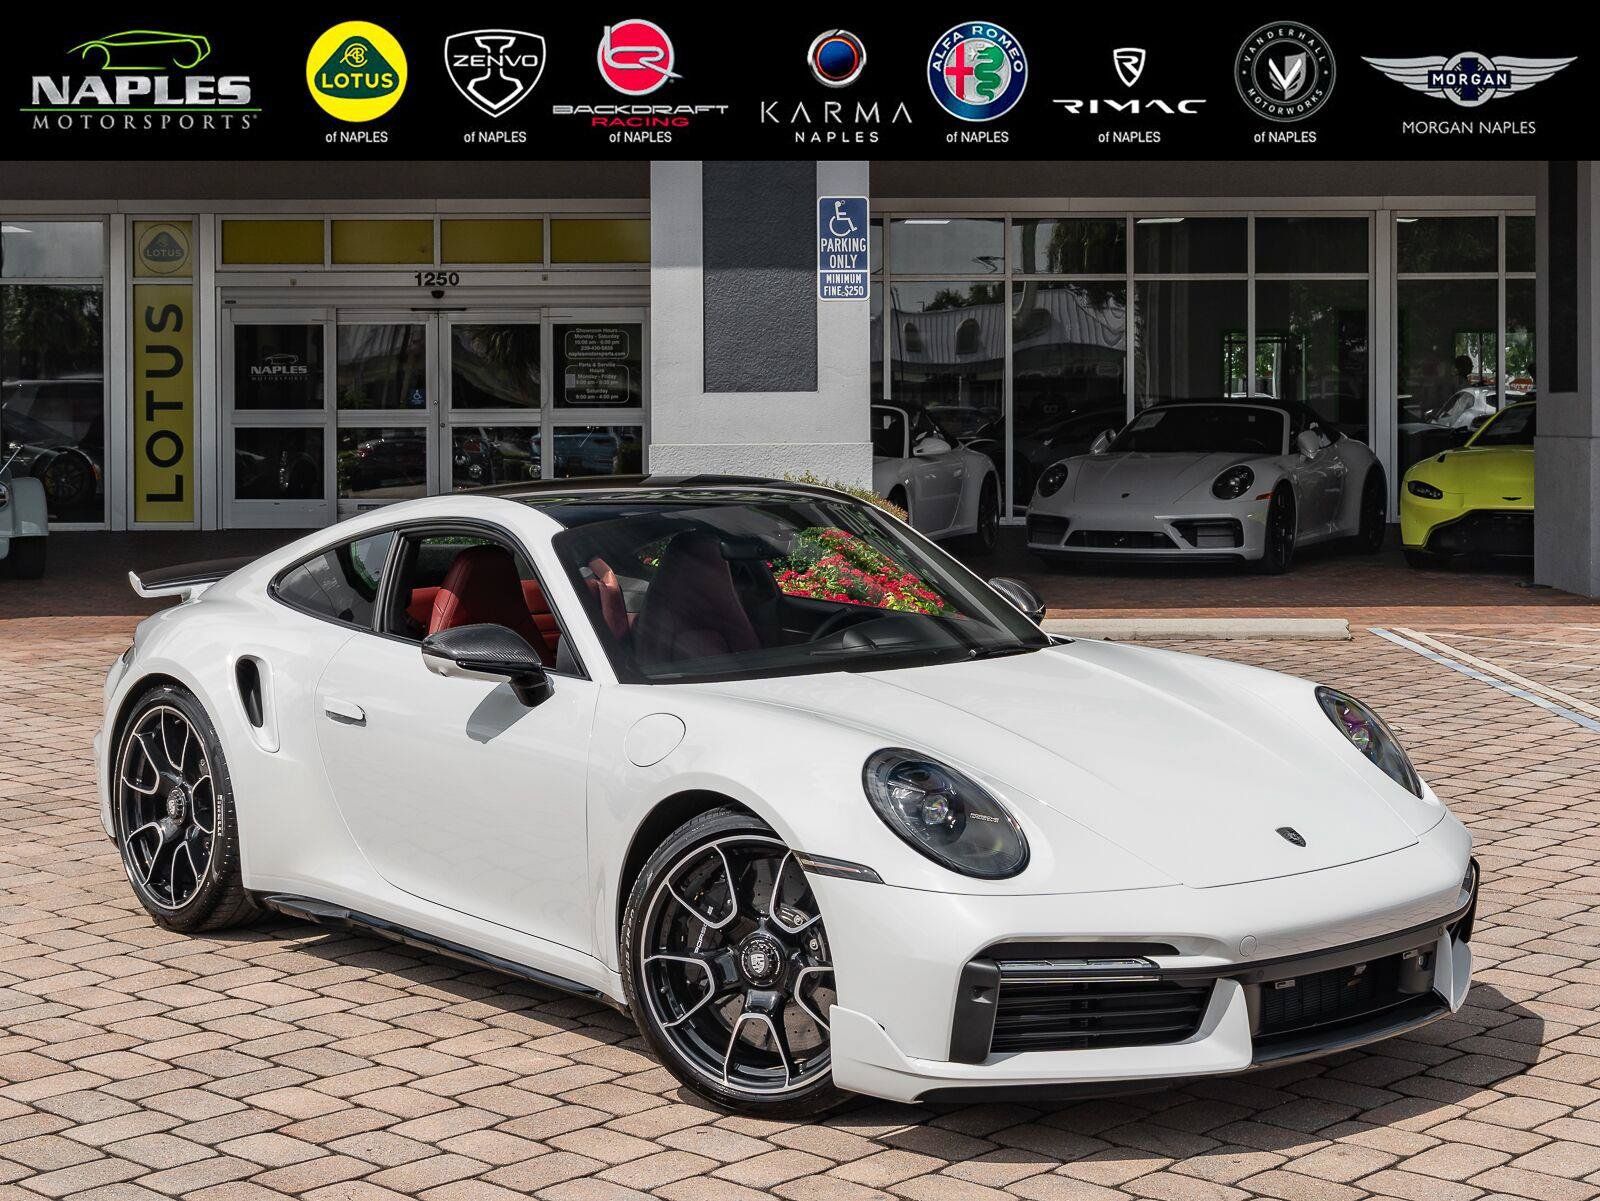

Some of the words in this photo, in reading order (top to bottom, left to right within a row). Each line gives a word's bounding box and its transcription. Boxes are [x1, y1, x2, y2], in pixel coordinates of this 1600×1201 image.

[820, 237, 867, 253] PARKING
[146, 248, 182, 257] LOTUS
[829, 254, 858, 269] ONLY
[414, 271, 460, 287] 1250
[826, 273, 862, 284] MINIMUM
[823, 285, 841, 296] FINE
[250, 365, 308, 375] NAPLES
[144, 303, 184, 503] LOTUS
